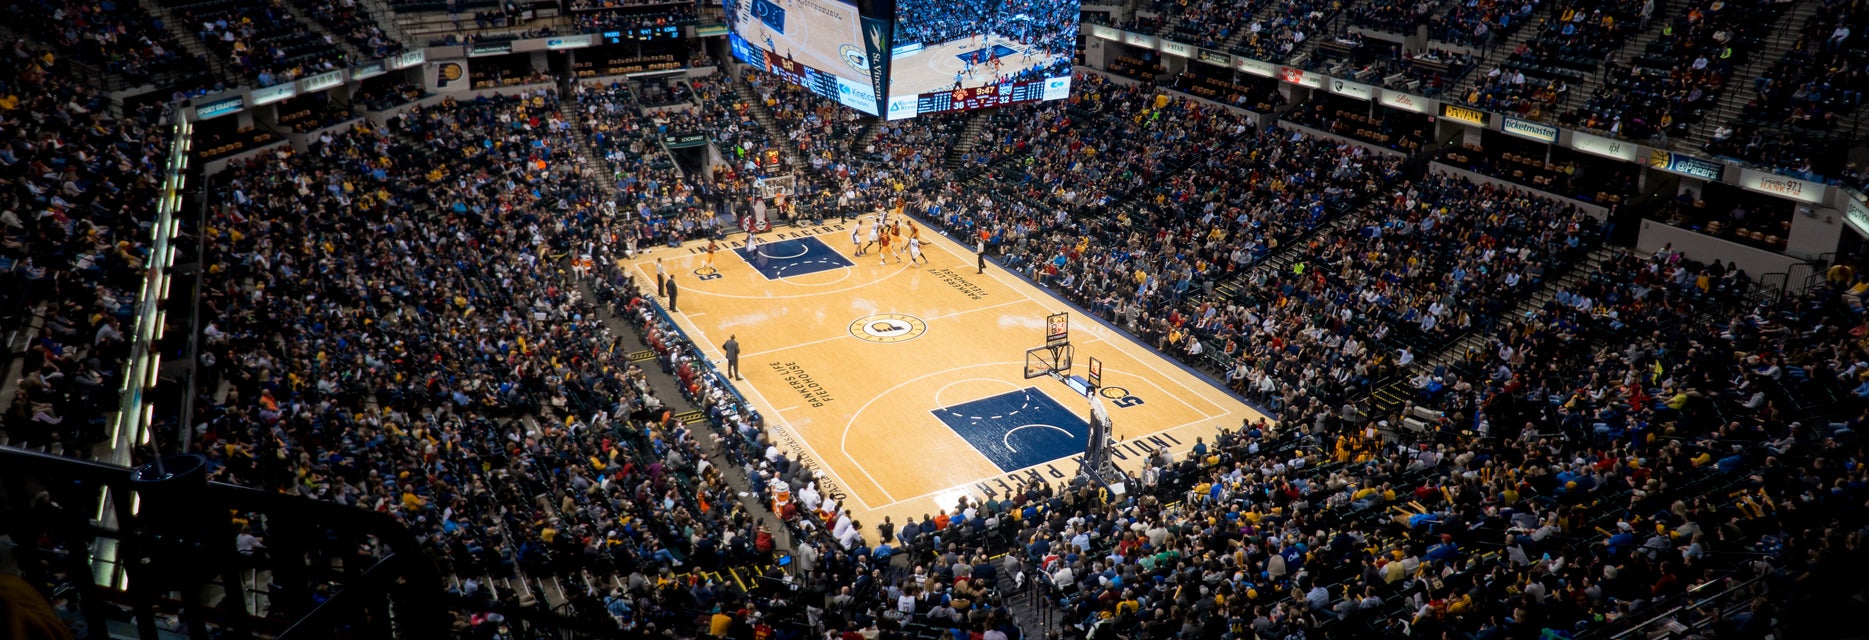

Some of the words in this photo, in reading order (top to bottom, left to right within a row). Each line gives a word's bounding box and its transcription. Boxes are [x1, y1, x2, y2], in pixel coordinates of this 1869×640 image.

[976, 86, 995, 95] 9:47
[953, 102, 965, 110] 36
[999, 96, 1010, 104] 32
[1505, 118, 1556, 138] ticketmaster
[1675, 160, 1718, 179] @Pacers
[777, 223, 846, 240] PACERS
[927, 268, 945, 279] LIFE
[939, 268, 989, 297] FIELDHOUSE
[944, 278, 982, 301] BANKERS
[769, 361, 789, 376] LIFE
[785, 361, 834, 402] FIELDHOUSE
[785, 375, 824, 409] BANKERS
